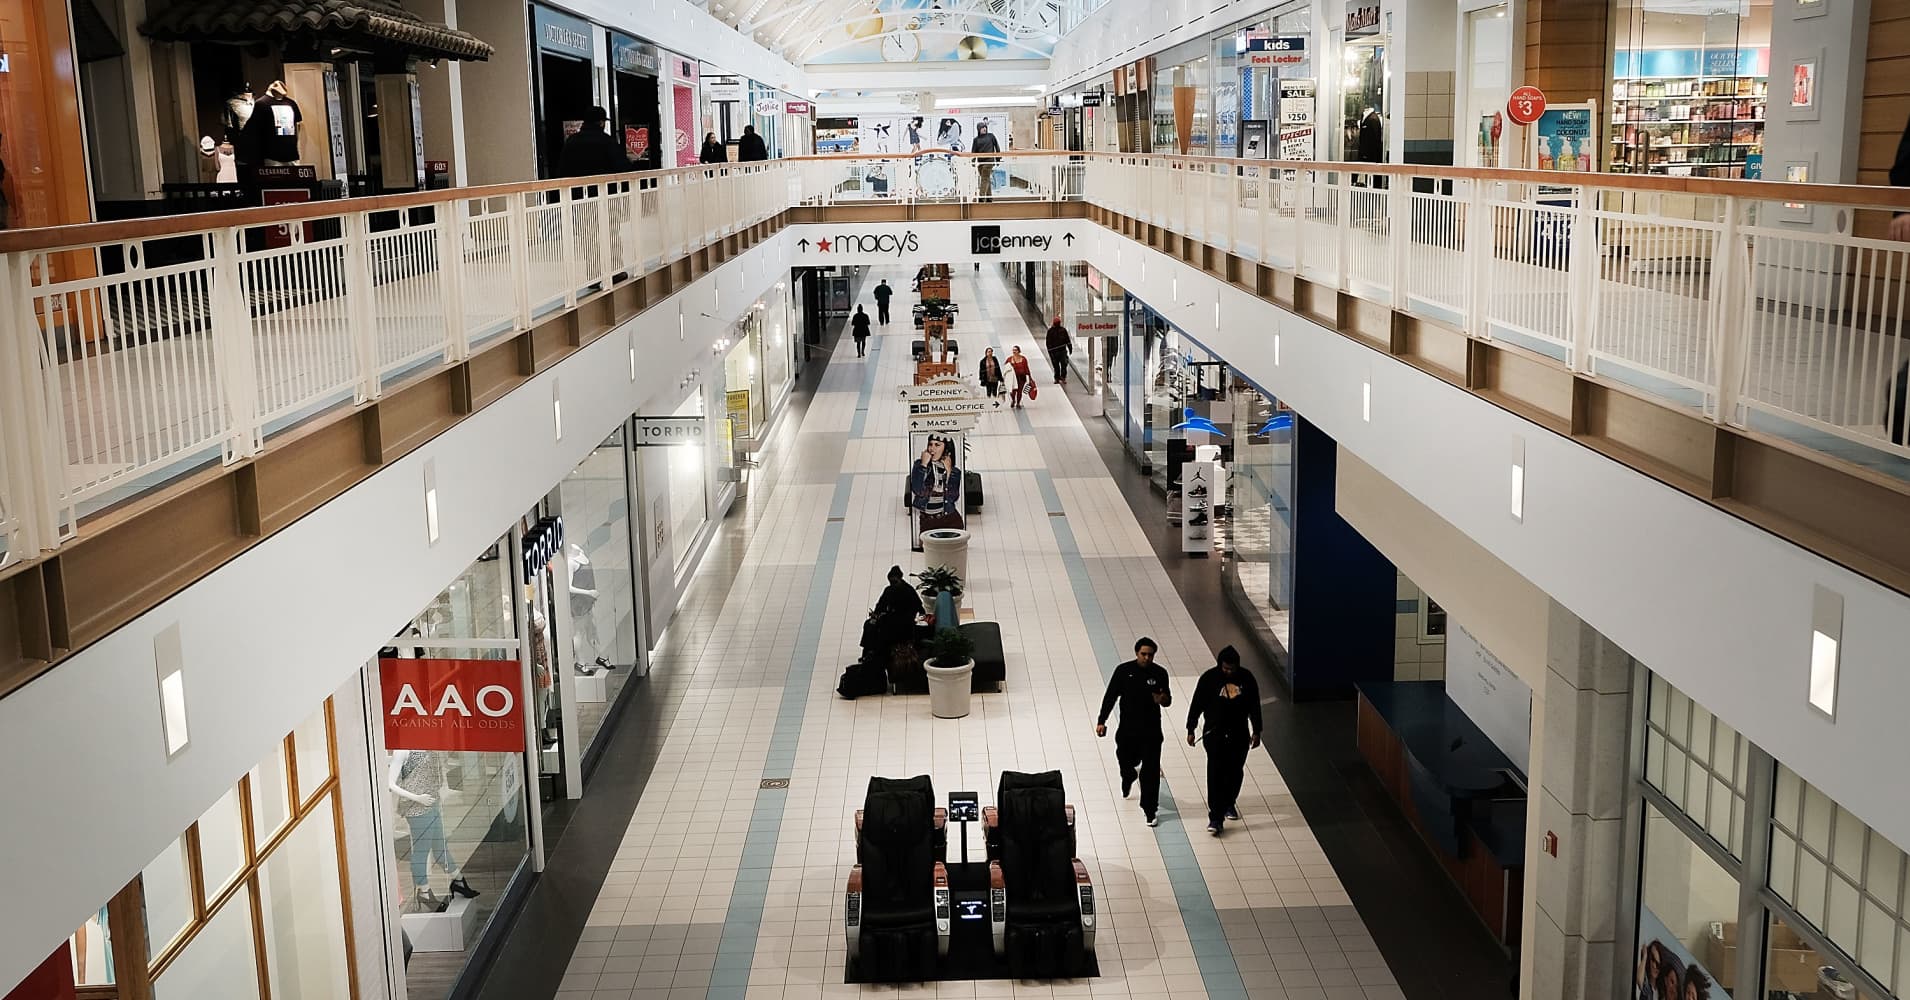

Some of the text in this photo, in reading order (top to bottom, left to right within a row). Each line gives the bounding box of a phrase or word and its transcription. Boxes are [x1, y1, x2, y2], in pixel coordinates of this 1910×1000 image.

[1264, 40, 1290, 50] kids
[1273, 55, 1302, 63] Locker
[1287, 90, 1311, 98] SALE
[1519, 101, 1532, 116] $3
[1288, 113, 1307, 121] $250
[1562, 111, 1582, 119] NEW!
[630, 141, 644, 149] FREE
[258, 168, 291, 176] CLEARANCE
[835, 230, 919, 258] macy's
[975, 233, 1052, 252] jcpenney
[918, 389, 962, 397] JCPENNEY
[955, 403, 984, 411] OFFICE
[927, 419, 957, 427] MACY'S
[642, 426, 702, 437] TORRID
[525, 516, 563, 584] TORRID
[390, 683, 514, 717] AAO
[391, 718, 516, 729] AGAINST ALL ODDS
